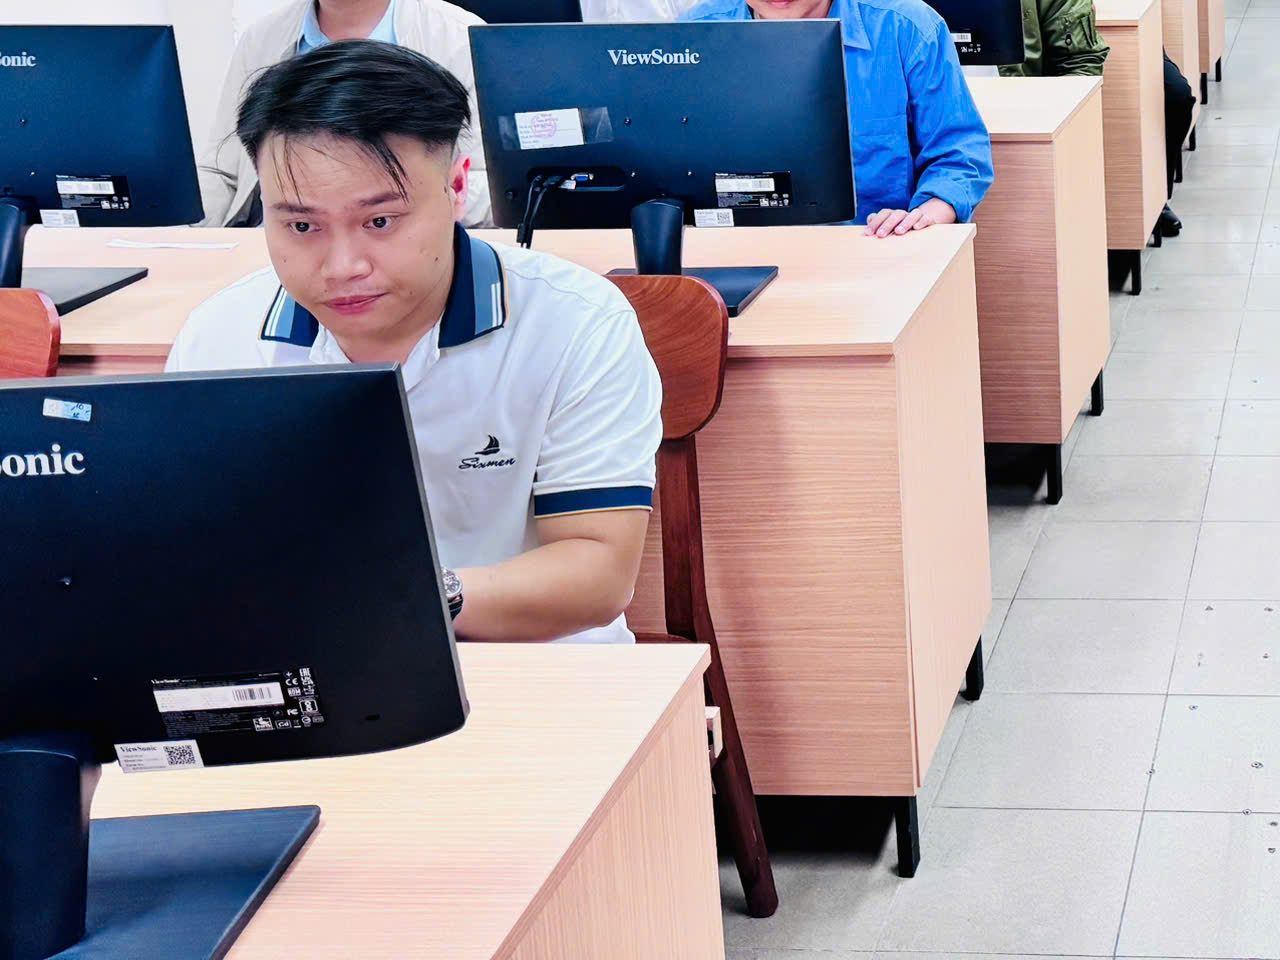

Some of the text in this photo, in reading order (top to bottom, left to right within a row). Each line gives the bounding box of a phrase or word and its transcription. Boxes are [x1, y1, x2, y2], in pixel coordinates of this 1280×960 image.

[0, 51, 37, 67] onic
[608, 48, 701, 66] ViewSonic
[0, 443, 86, 477] onic
[458, 457, 516, 470] Sixmen
